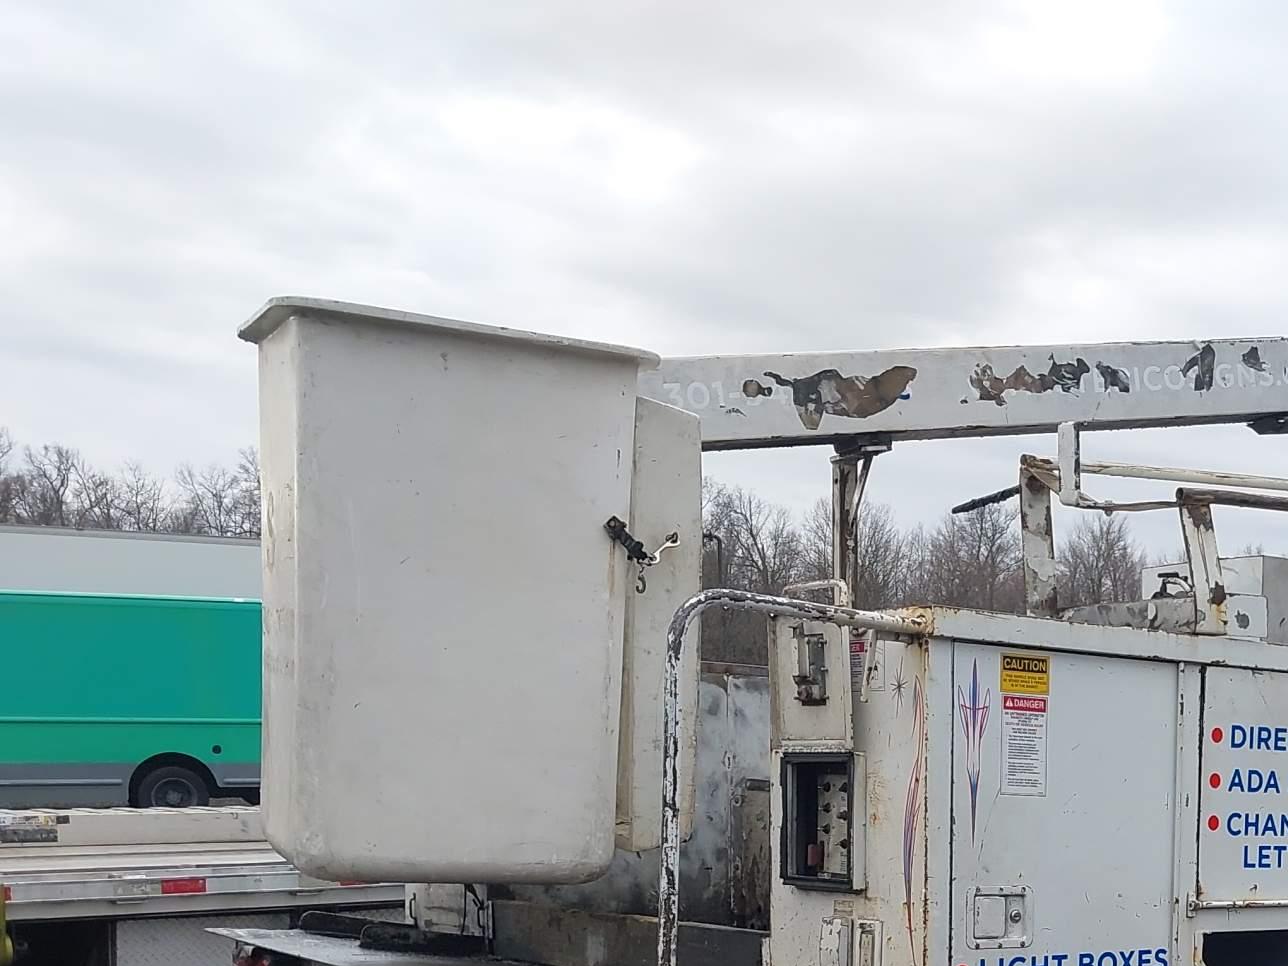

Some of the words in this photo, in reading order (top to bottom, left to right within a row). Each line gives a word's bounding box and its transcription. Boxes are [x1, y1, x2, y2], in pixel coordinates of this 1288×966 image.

[1004, 658, 1047, 672] CAUTION
[1013, 699, 1045, 711] DANGER
[1228, 768, 1281, 794] ADA
